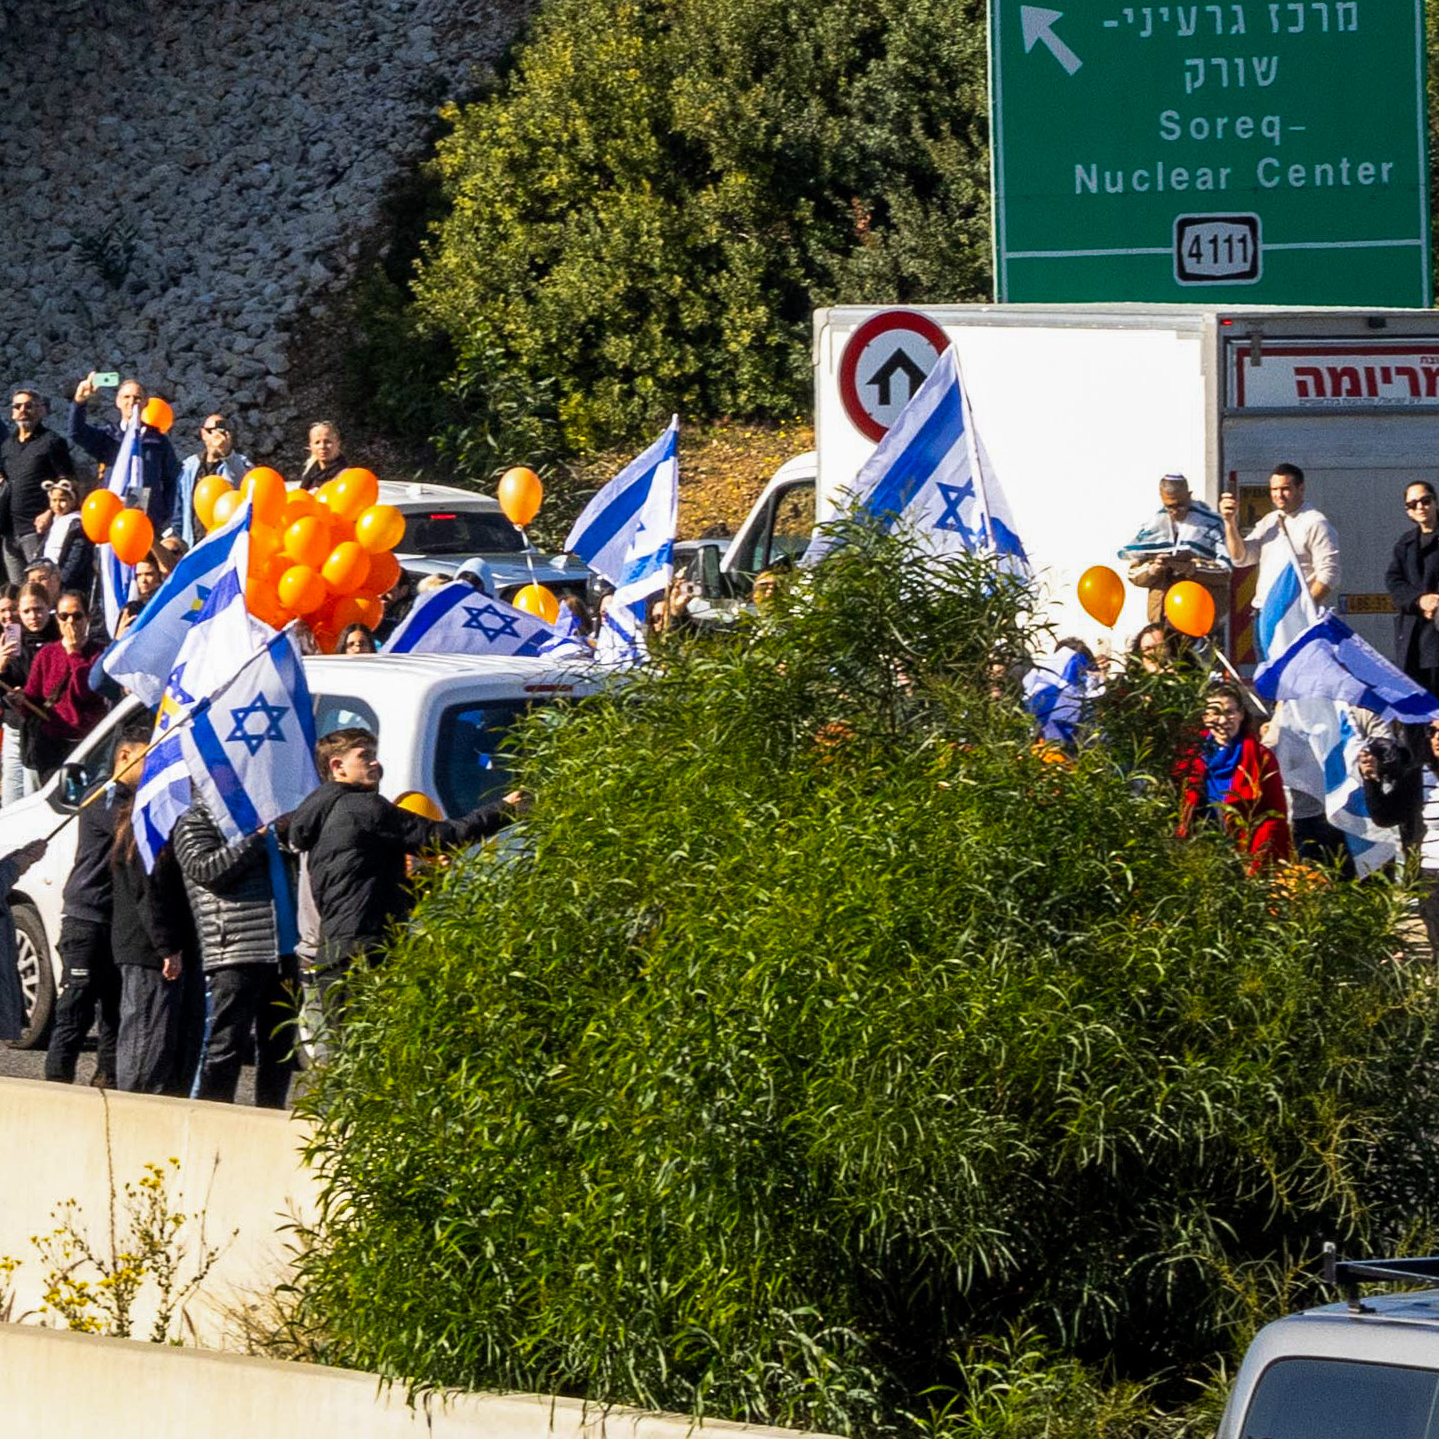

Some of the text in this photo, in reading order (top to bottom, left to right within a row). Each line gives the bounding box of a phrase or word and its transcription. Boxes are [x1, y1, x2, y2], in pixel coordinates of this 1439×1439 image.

[1268, 1, 1358, 33] מרכז
[1184, 55, 1279, 95] שורק
[1074, 156, 1395, 195] Nuclear Center
[1187, 233, 1249, 265] 4111
